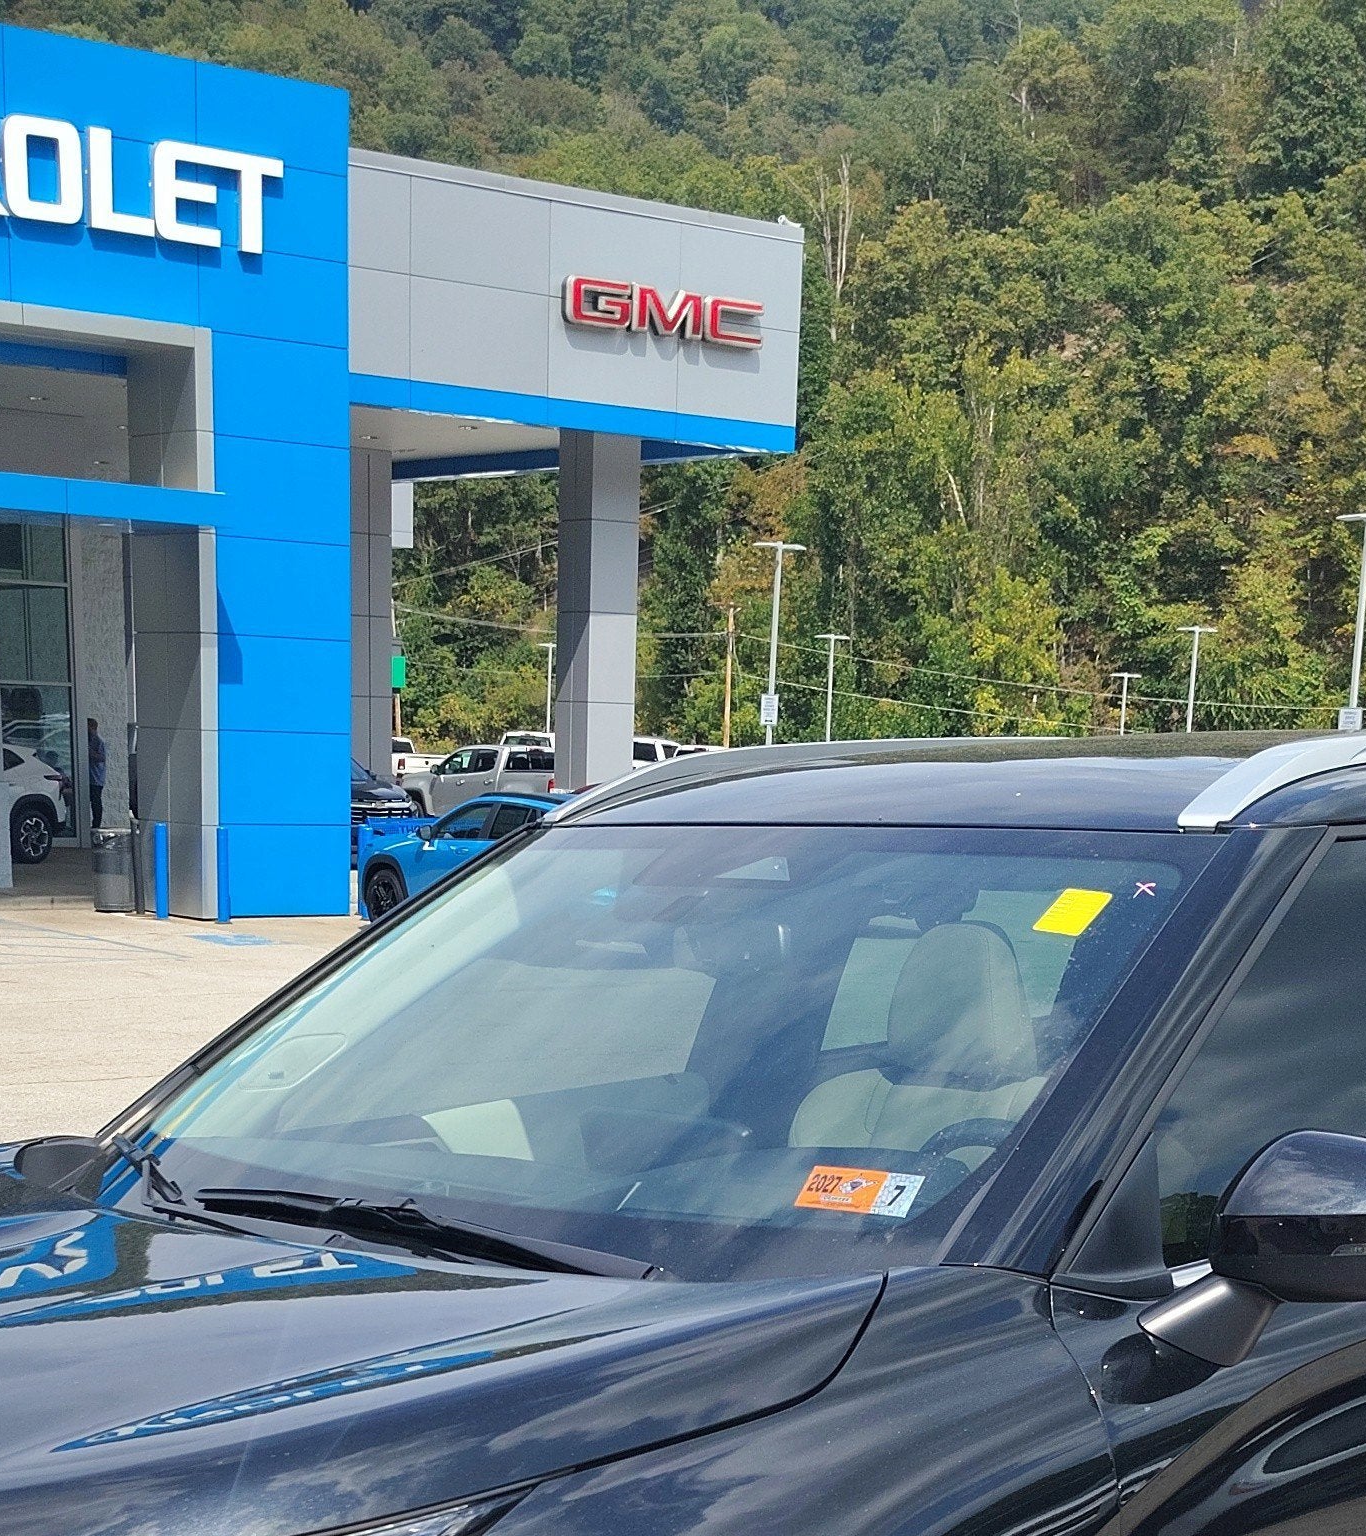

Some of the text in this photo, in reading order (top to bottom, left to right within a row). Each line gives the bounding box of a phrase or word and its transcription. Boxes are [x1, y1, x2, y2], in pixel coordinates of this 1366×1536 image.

[561, 275, 765, 350] GMC
[806, 1173, 843, 1194] 2027
[887, 1184, 907, 1206] 7
